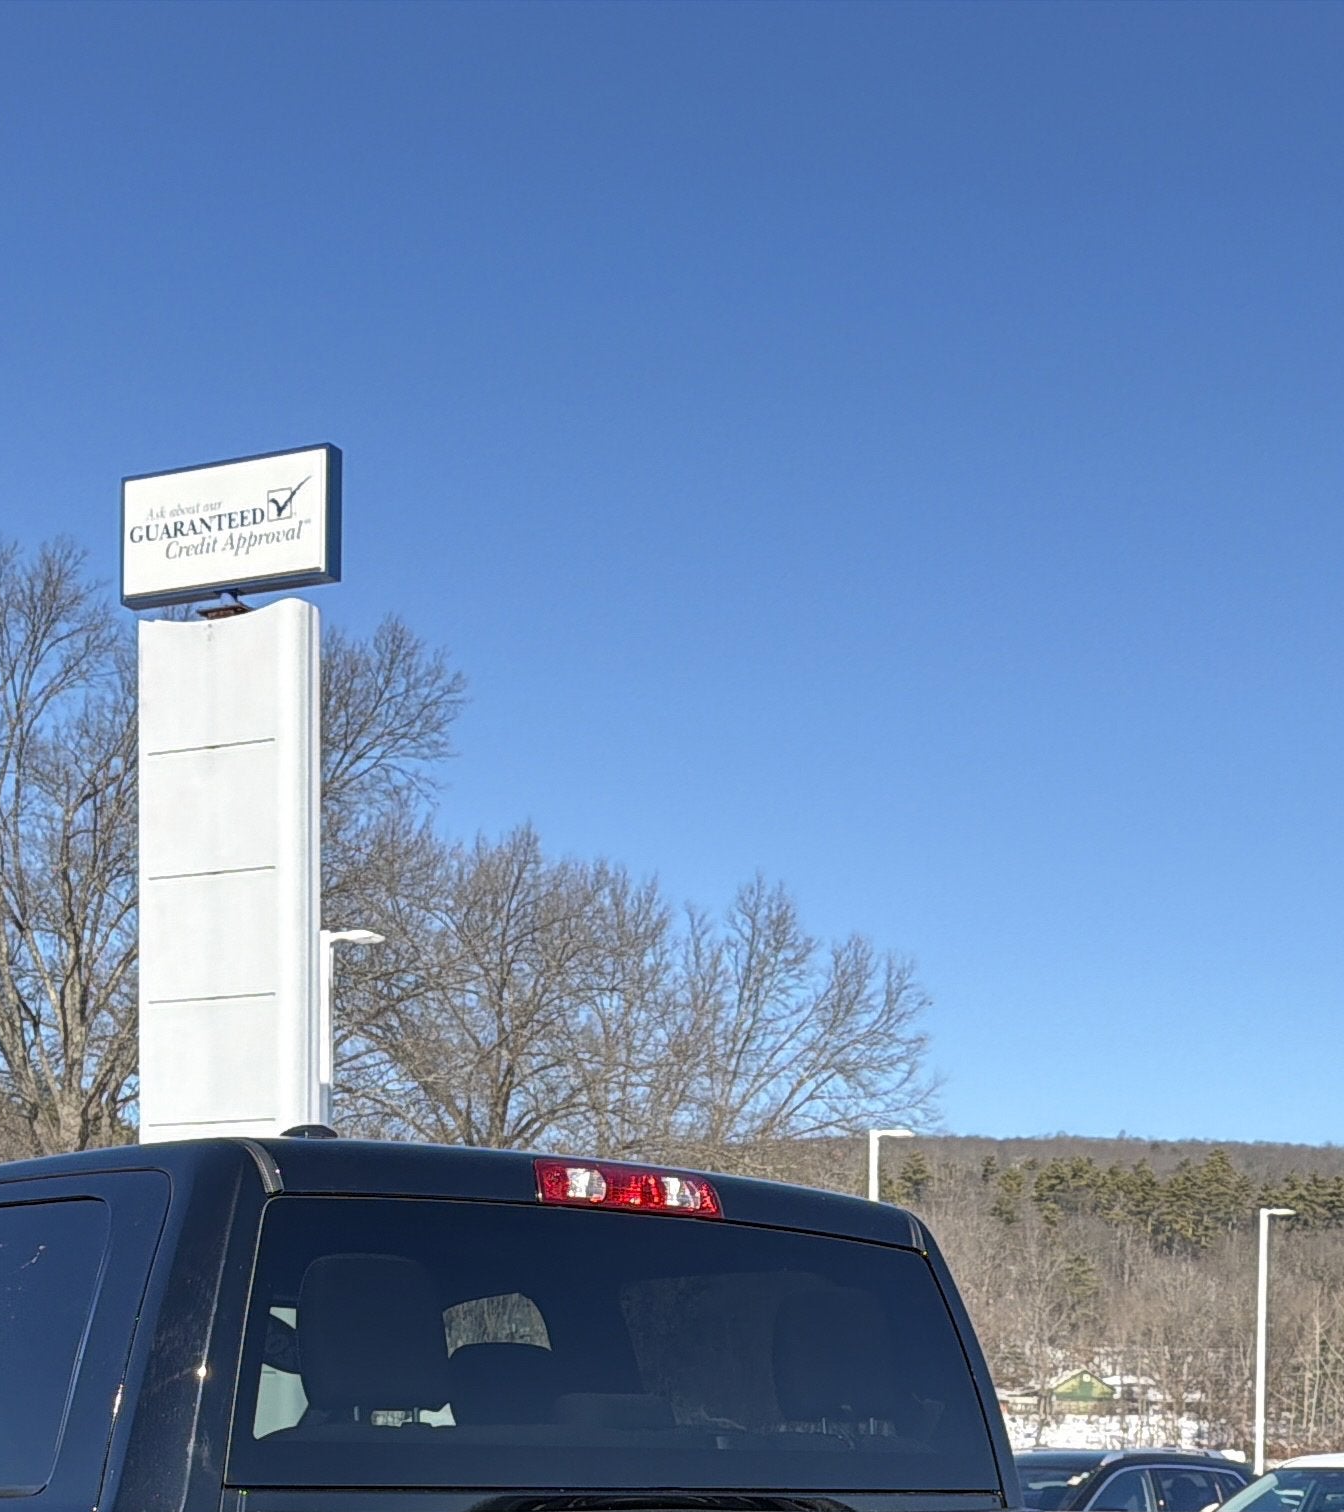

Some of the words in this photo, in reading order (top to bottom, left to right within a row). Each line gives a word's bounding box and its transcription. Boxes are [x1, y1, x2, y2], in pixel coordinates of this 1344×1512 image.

[129, 507, 265, 544] GUARANTEED
[146, 507, 167, 521] Ask
[169, 503, 201, 518] about
[203, 501, 223, 512] our
[165, 536, 218, 560] Credit
[221, 520, 303, 557] Approval
